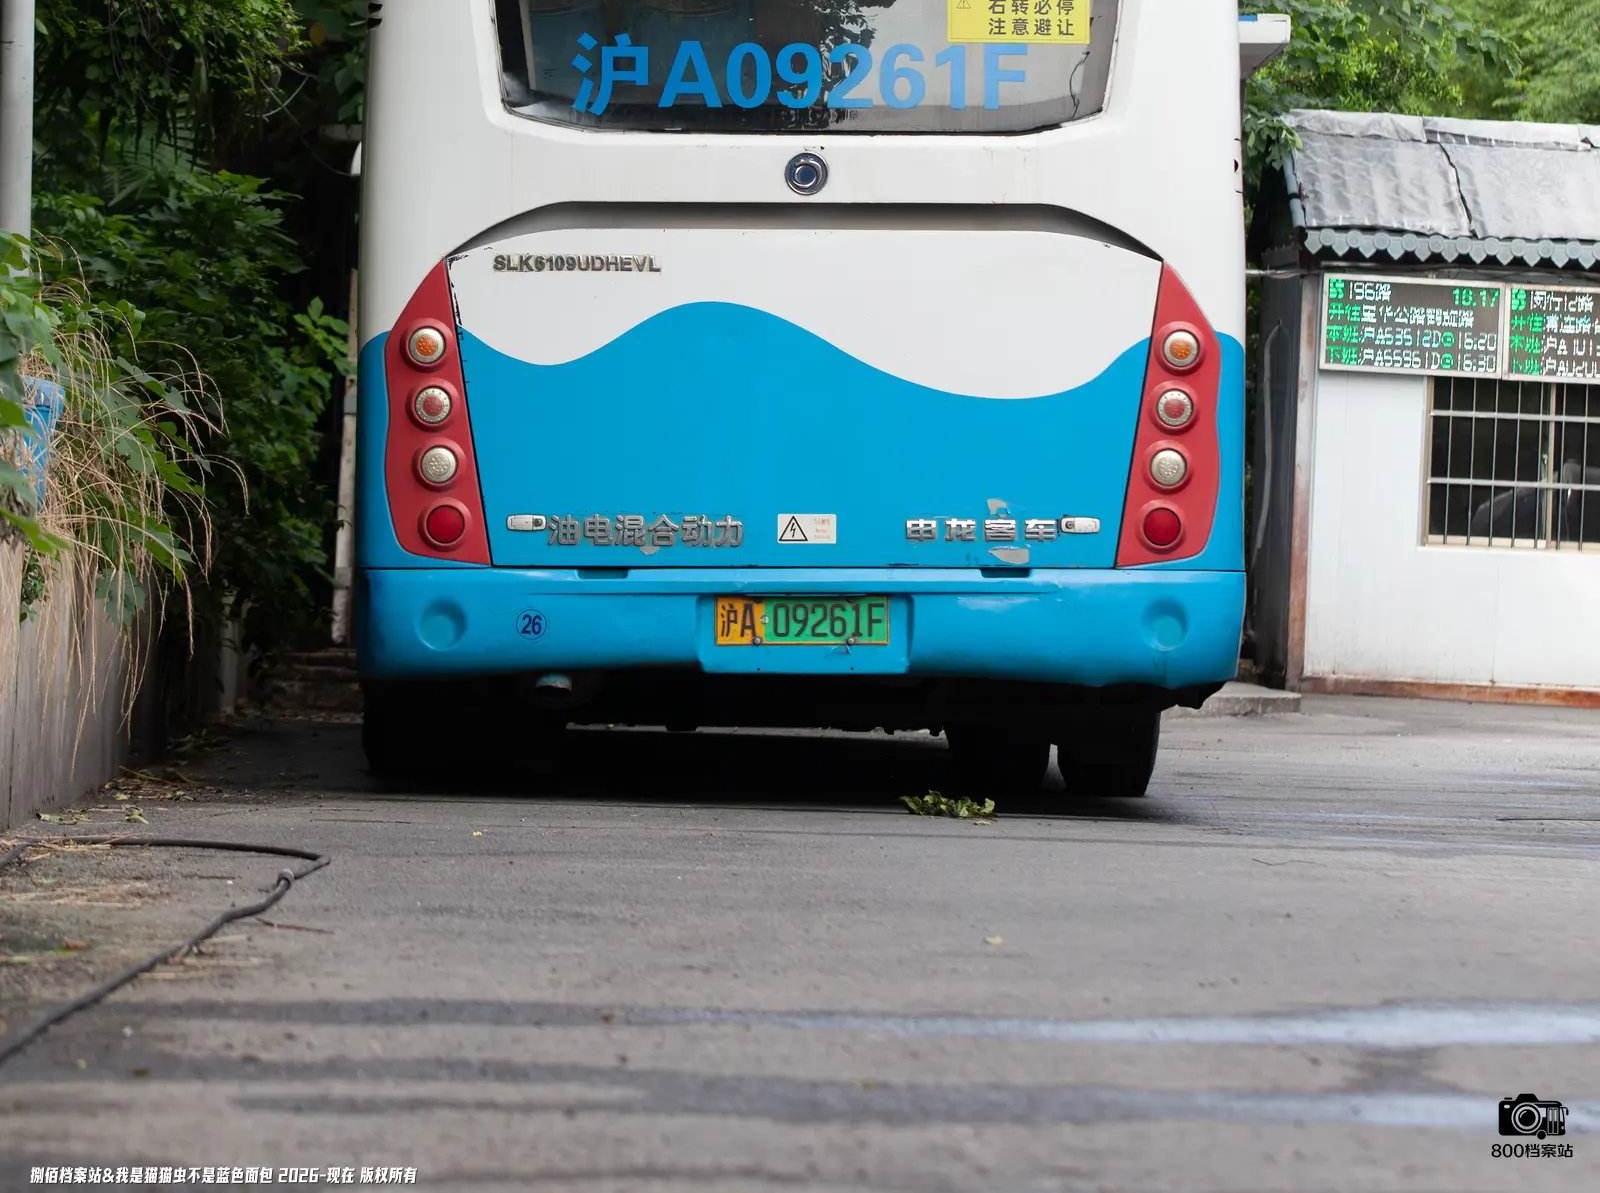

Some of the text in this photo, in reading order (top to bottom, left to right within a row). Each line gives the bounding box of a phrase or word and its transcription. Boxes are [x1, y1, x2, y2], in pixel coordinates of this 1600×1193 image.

[988, 18, 1075, 36] 注意避让
[571, 32, 1028, 116] 沪A09261F
[493, 254, 661, 272] SLK6109UDHEVL
[548, 514, 744, 547] 油电混合动力
[906, 518, 1056, 542] 申龙客车
[521, 614, 543, 635] 26
